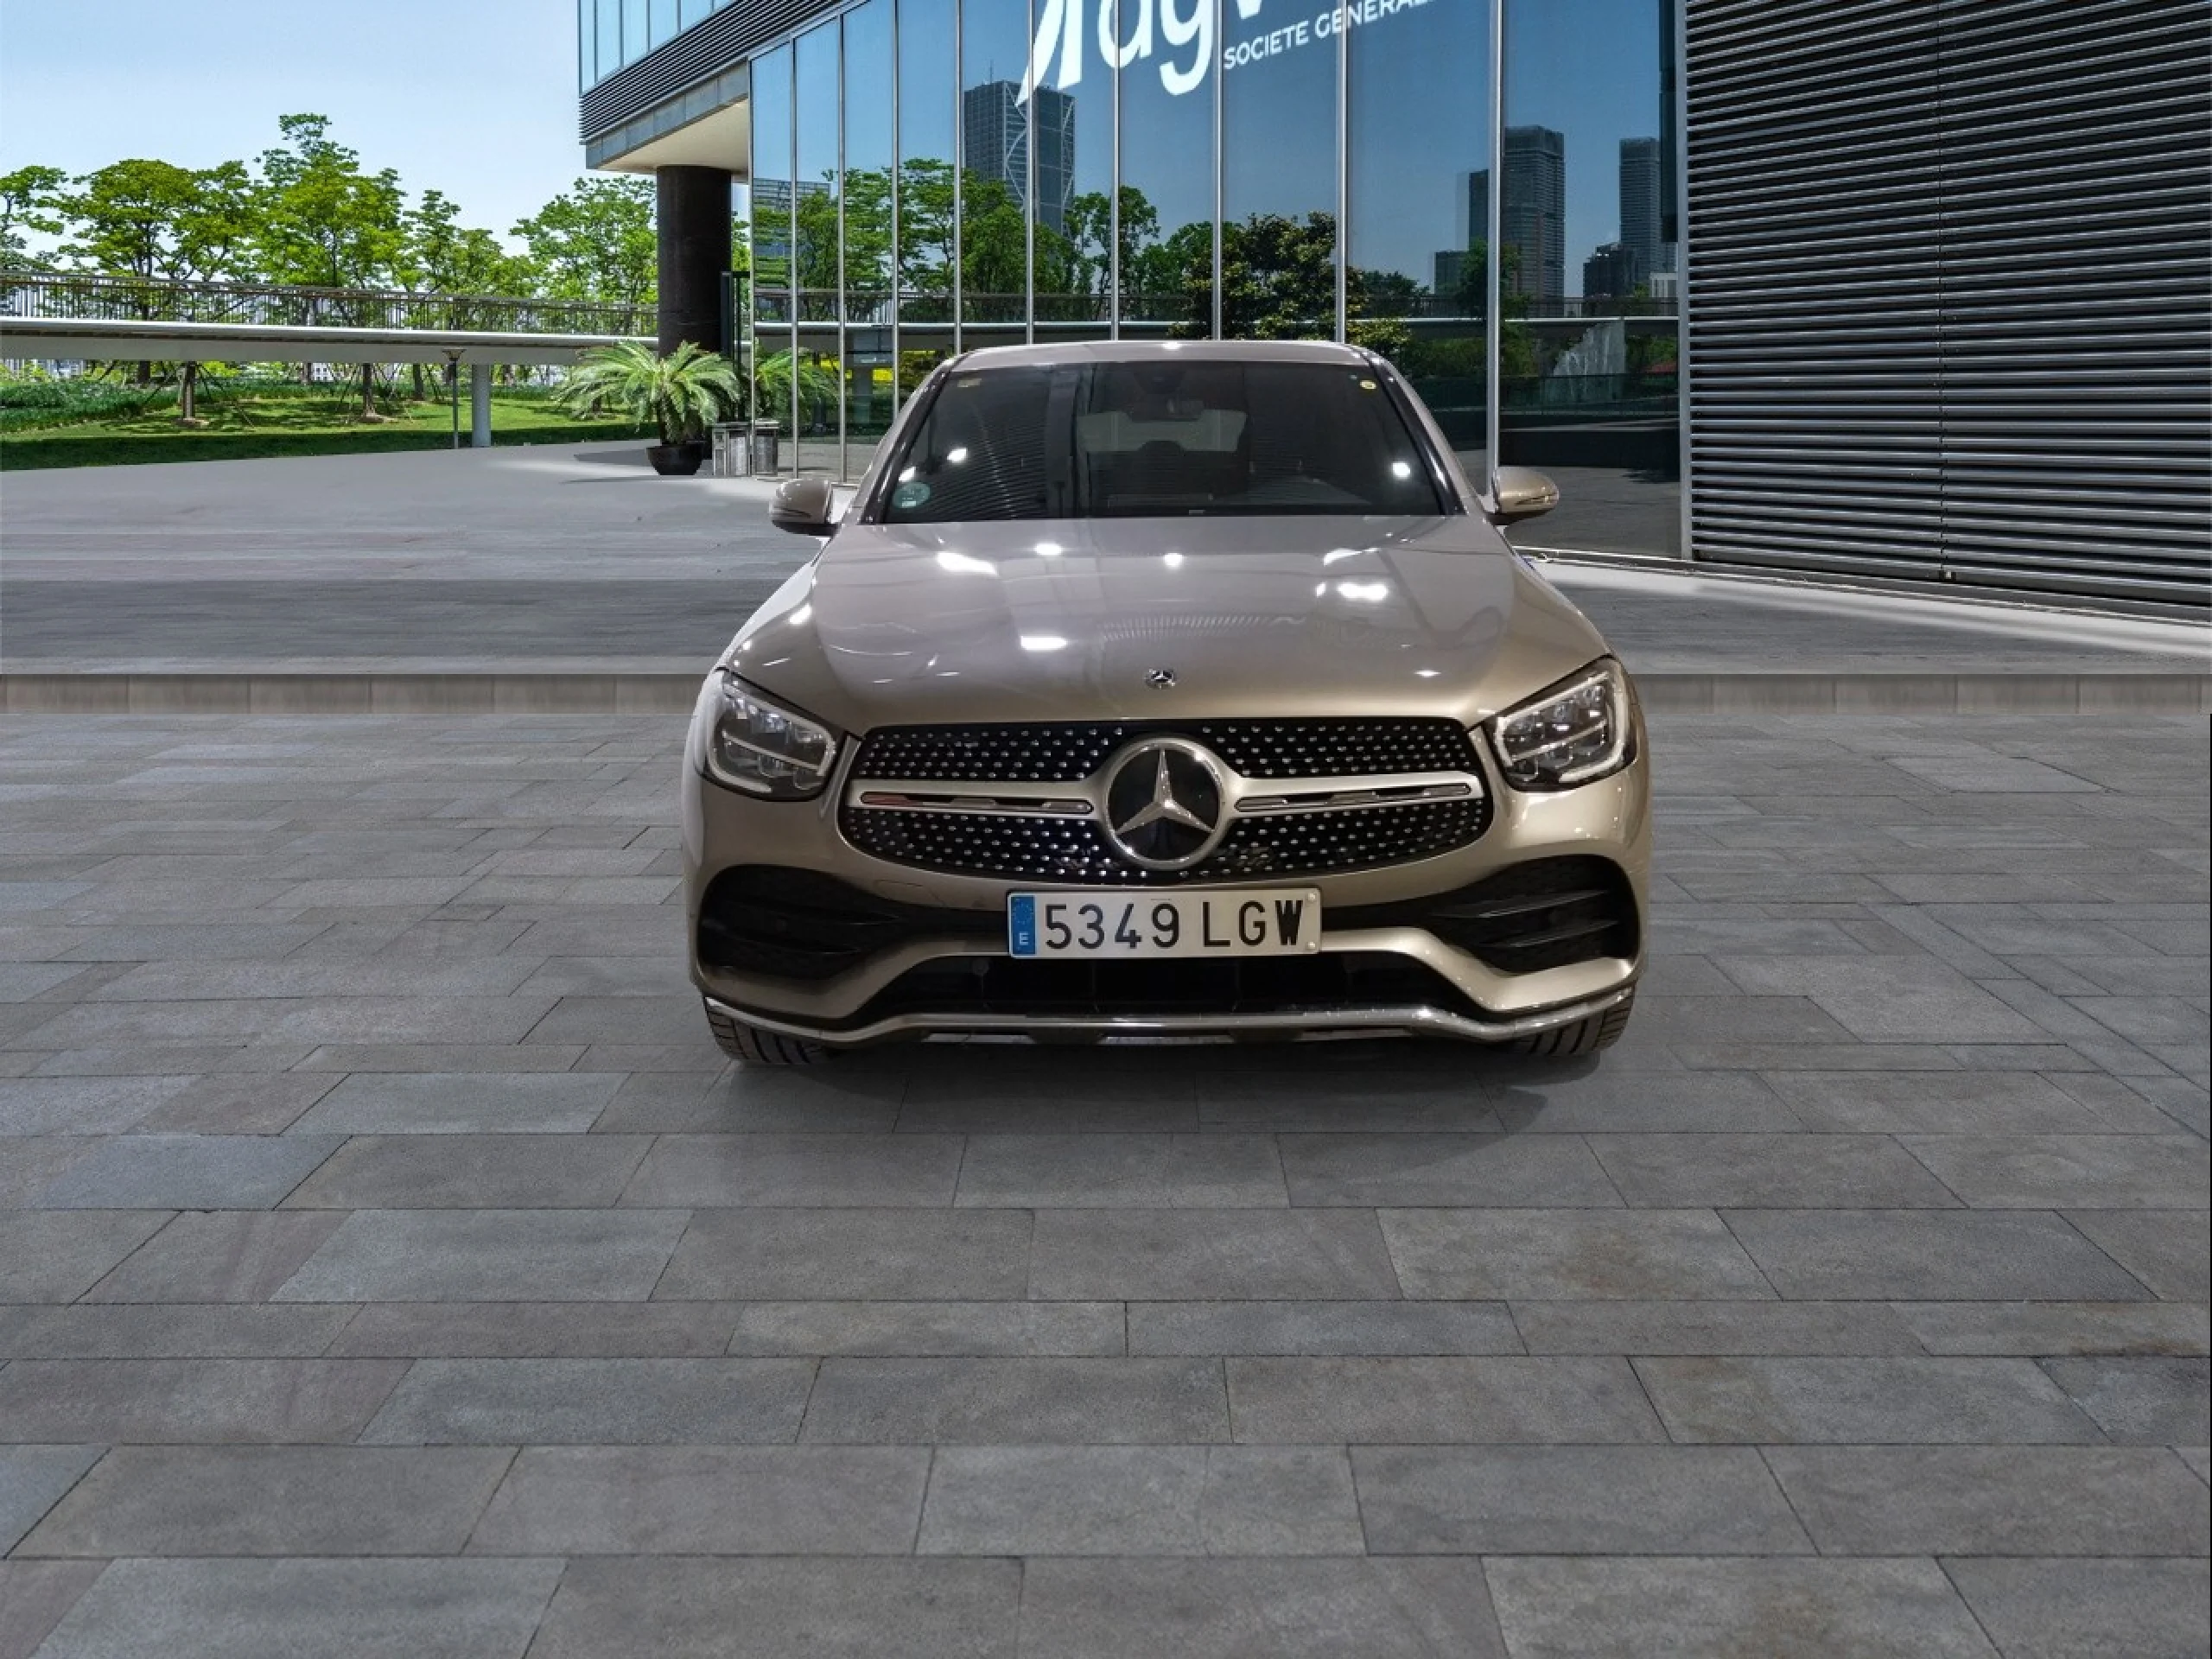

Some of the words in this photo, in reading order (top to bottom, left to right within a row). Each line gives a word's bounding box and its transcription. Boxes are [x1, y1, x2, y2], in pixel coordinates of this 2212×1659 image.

[1224, 20, 1309, 69] SOCIETE
[1019, 931, 1029, 946] E
[1046, 902, 1179, 950] 5349
[1202, 899, 1304, 948] LGW
